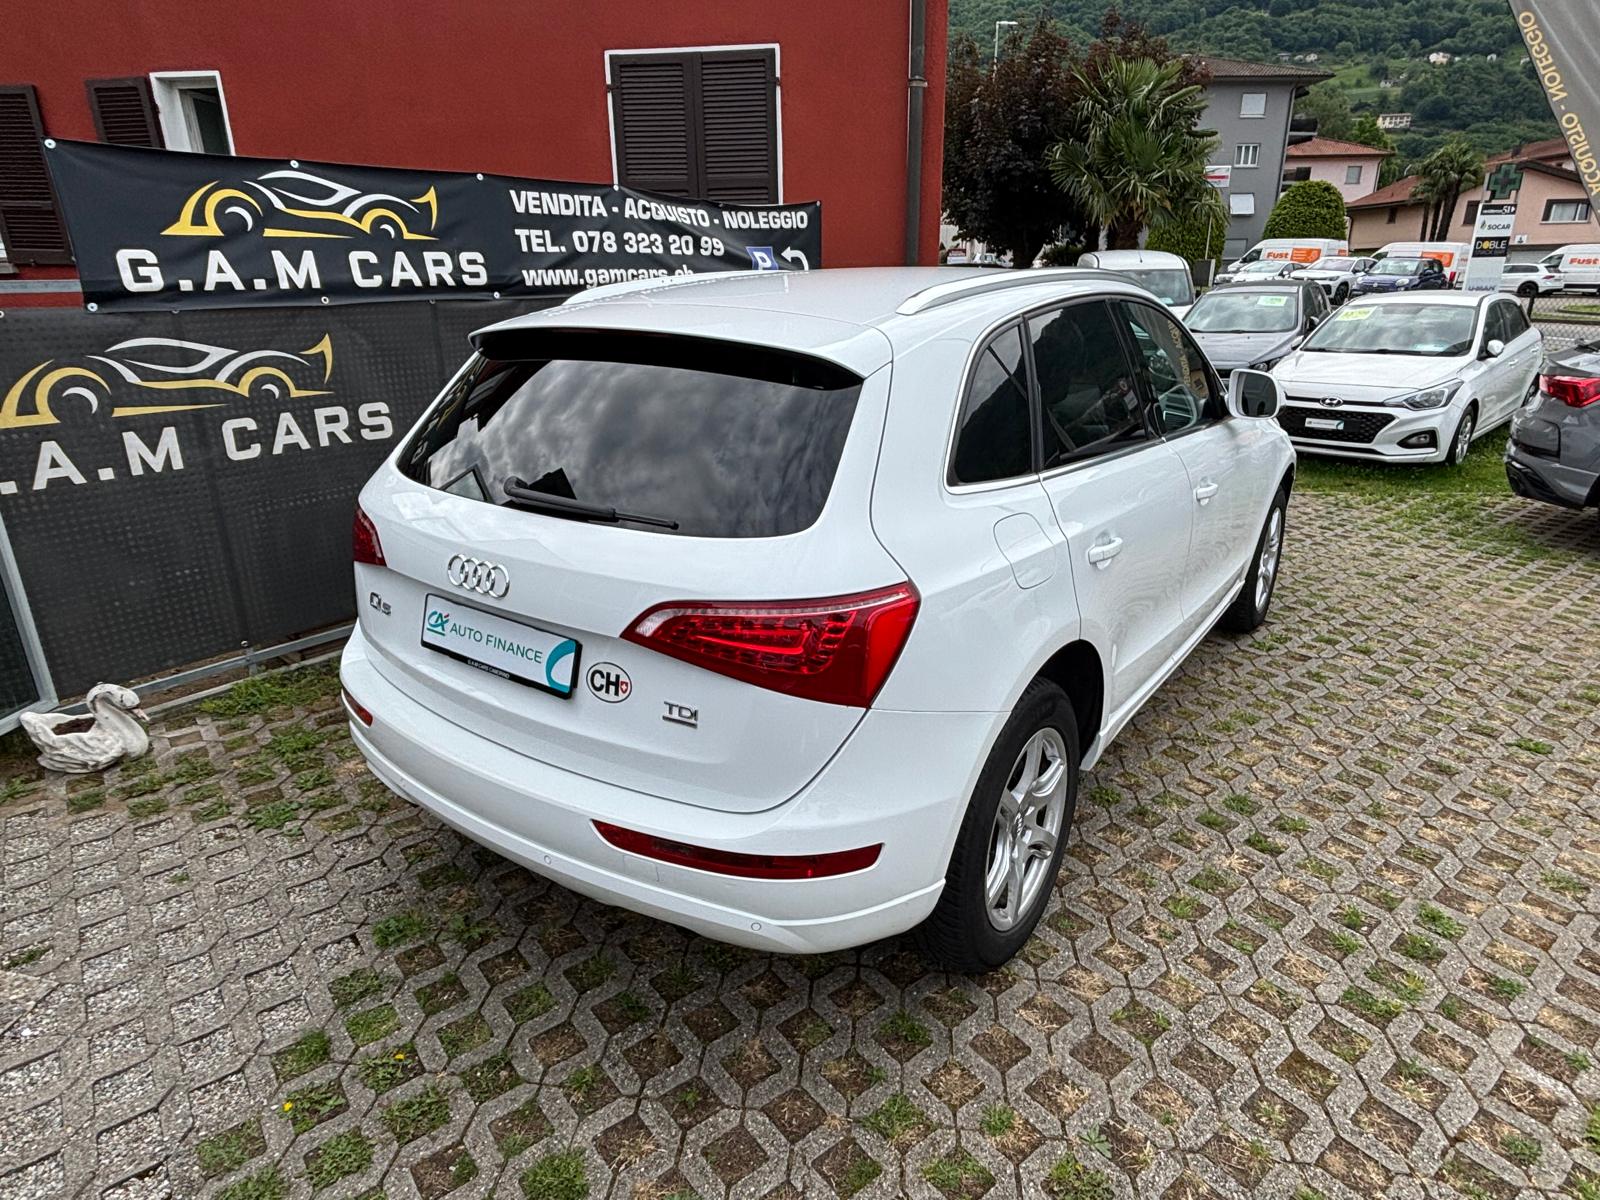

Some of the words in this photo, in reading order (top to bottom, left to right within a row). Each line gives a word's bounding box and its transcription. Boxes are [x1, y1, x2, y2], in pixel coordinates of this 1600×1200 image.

[509, 190, 608, 217] VENDITA
[624, 197, 710, 228] ACQUISTO
[722, 210, 808, 229] NOLEGGIO
[515, 229, 566, 253] TEL.
[572, 231, 617, 253] 078
[623, 232, 664, 255] 323
[670, 235, 694, 255] 20
[700, 236, 725, 257] 99
[115, 249, 321, 292] G.A.M
[348, 251, 488, 287] CARS
[522, 264, 694, 289] www.gamcarsch
[222, 402, 393, 462] CARS
[370, 591, 392, 616] Q5
[449, 622, 483, 643] AUTO
[485, 634, 544, 664] FINANCE
[590, 669, 620, 696] CH
[663, 700, 698, 722] TDI
